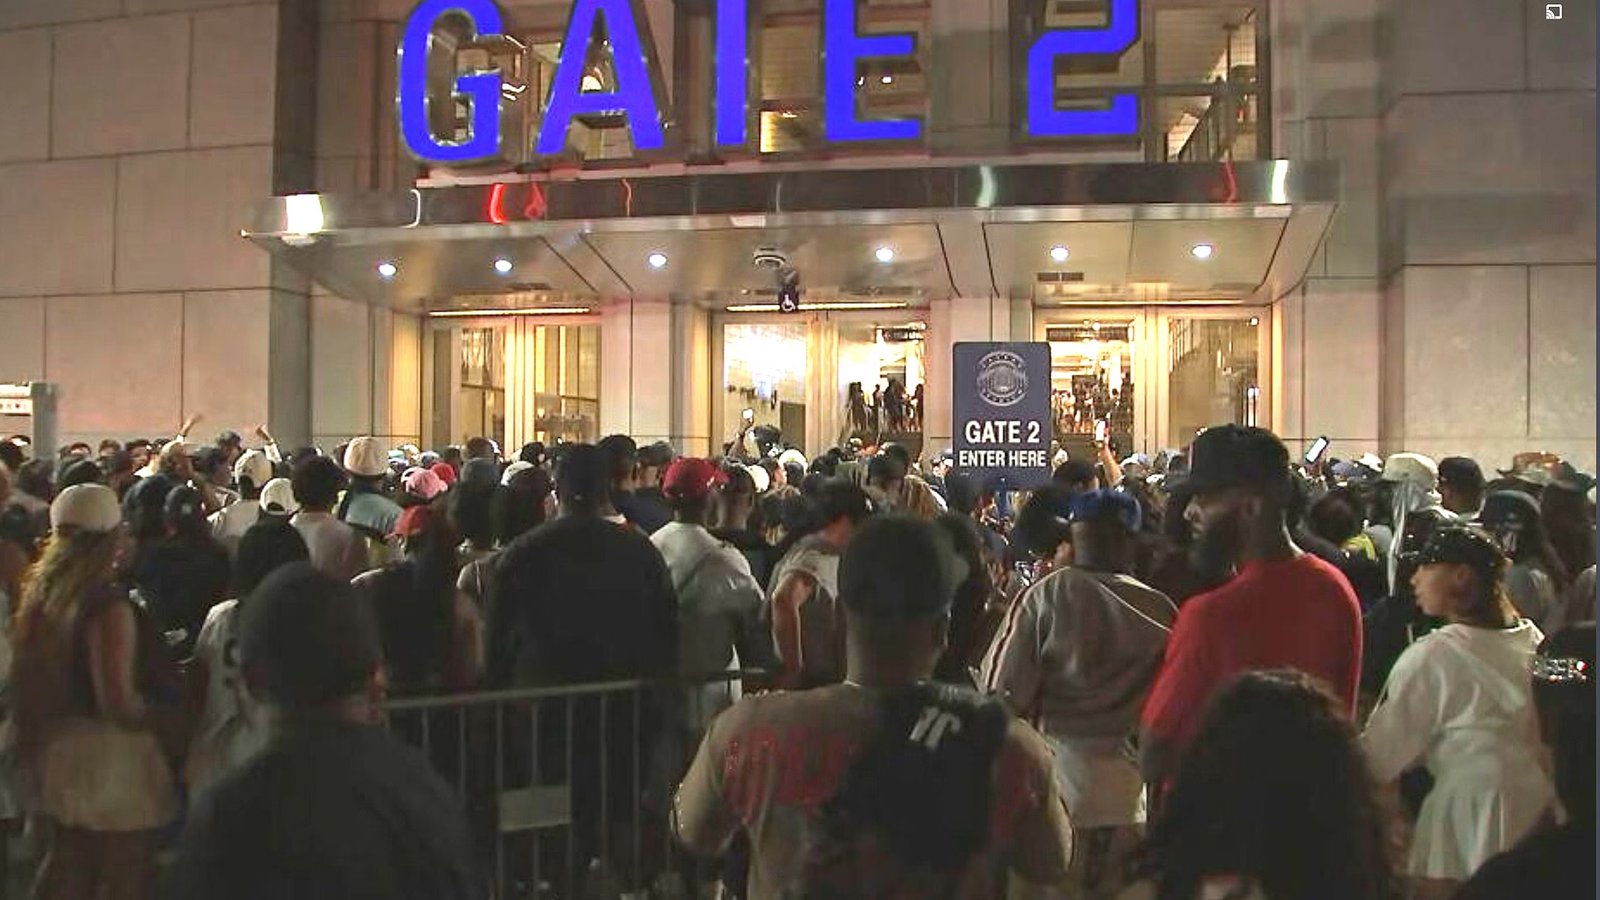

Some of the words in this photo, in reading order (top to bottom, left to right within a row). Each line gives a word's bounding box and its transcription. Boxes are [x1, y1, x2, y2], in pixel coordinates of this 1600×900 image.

[1027, 0, 1138, 136] 2
[965, 420, 1021, 443] GATE
[1027, 420, 1040, 443] 2
[959, 450, 1006, 467] ENTER
[1009, 450, 1047, 467] HERE
